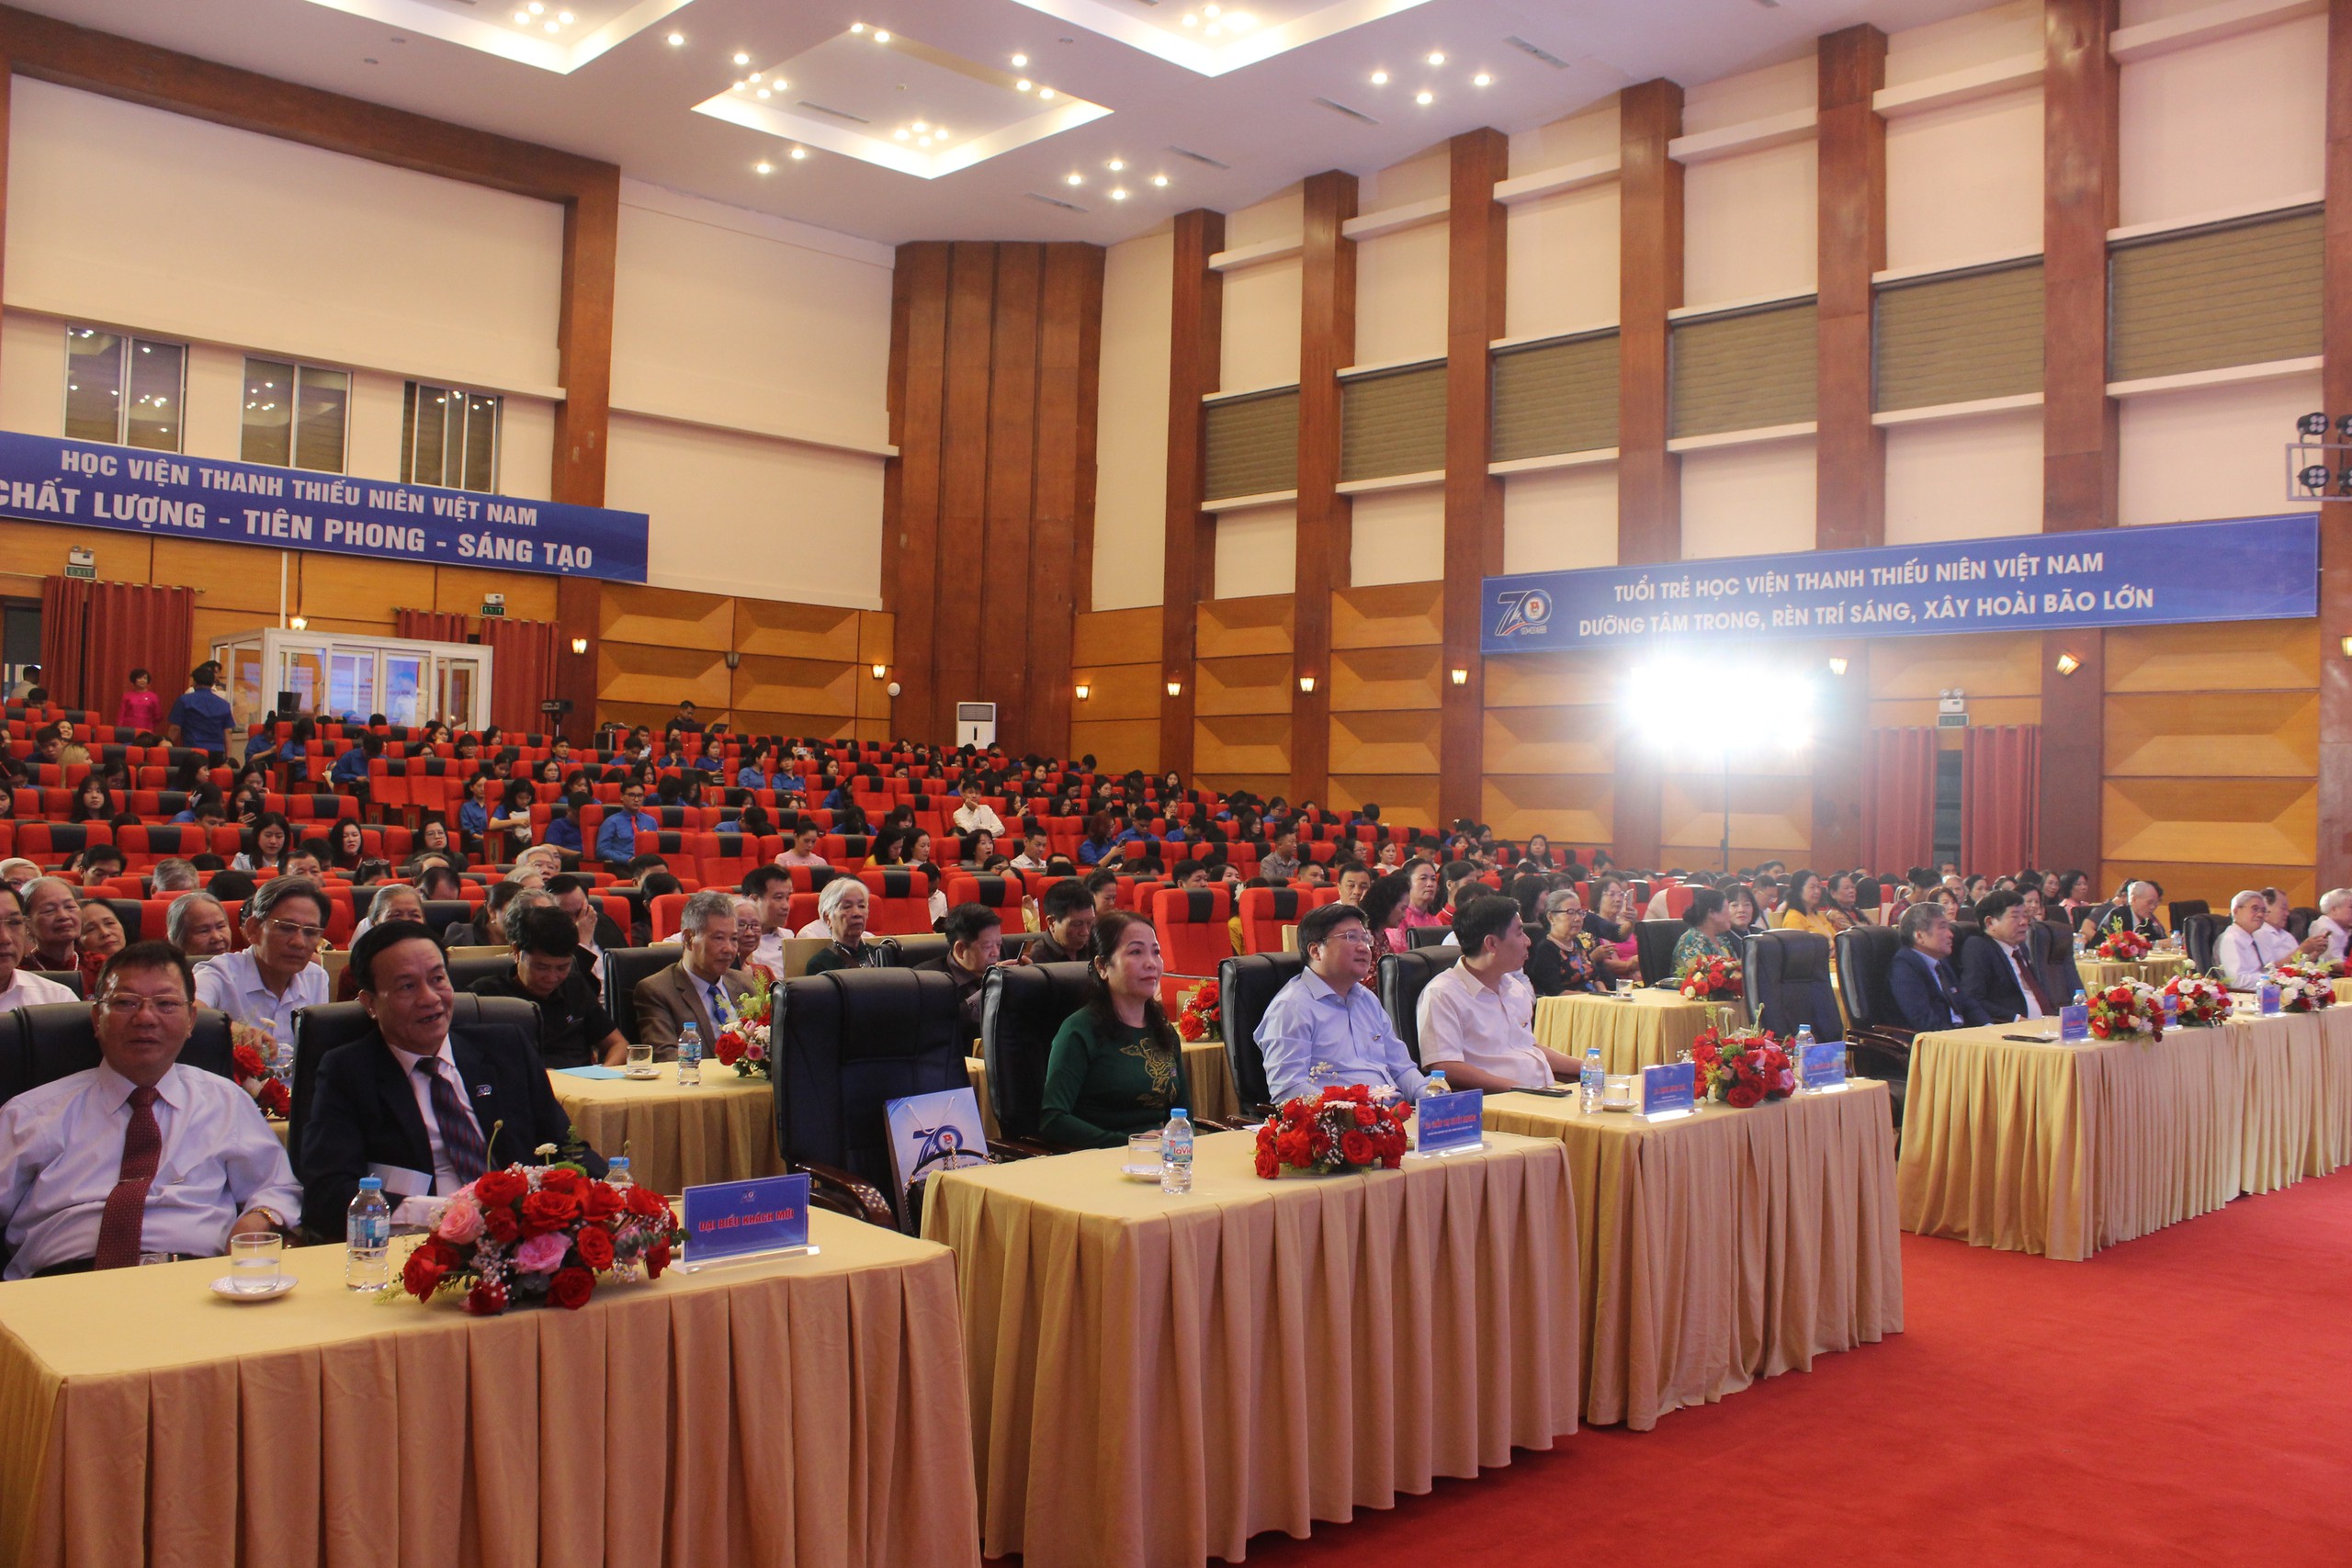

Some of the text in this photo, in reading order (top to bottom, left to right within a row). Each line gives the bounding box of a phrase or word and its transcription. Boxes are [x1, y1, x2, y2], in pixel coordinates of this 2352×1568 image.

[62, 449, 537, 526] HỌC VIỆN THANH THIẾU NIÊN VIỆT NAM
[94, 491, 206, 529] LƯỢNG
[243, 508, 312, 541] TIÊN
[324, 518, 424, 552] PHONG
[458, 531, 533, 564] SÁNG
[543, 542, 593, 571] TẠO
[70, 567, 93, 578] EXIT
[1614, 552, 2104, 602] TUỔI TRẺ HỌC VIỆN THANH THIẾU NIÊN VIỆT NAM
[1579, 615, 1645, 636] DƯỠNG
[1650, 611, 1689, 633] TÂM
[1693, 611, 1766, 631] TRONG,
[1815, 602, 1844, 625] TRÍ
[1849, 600, 1917, 624] SÁNG,
[1924, 595, 1970, 619] XÂY
[1977, 590, 2036, 616] HOÀI
[2043, 589, 2096, 614] BÃO
[2103, 584, 2154, 609] LỚN
[741, 1212, 774, 1225] KHÁCH
